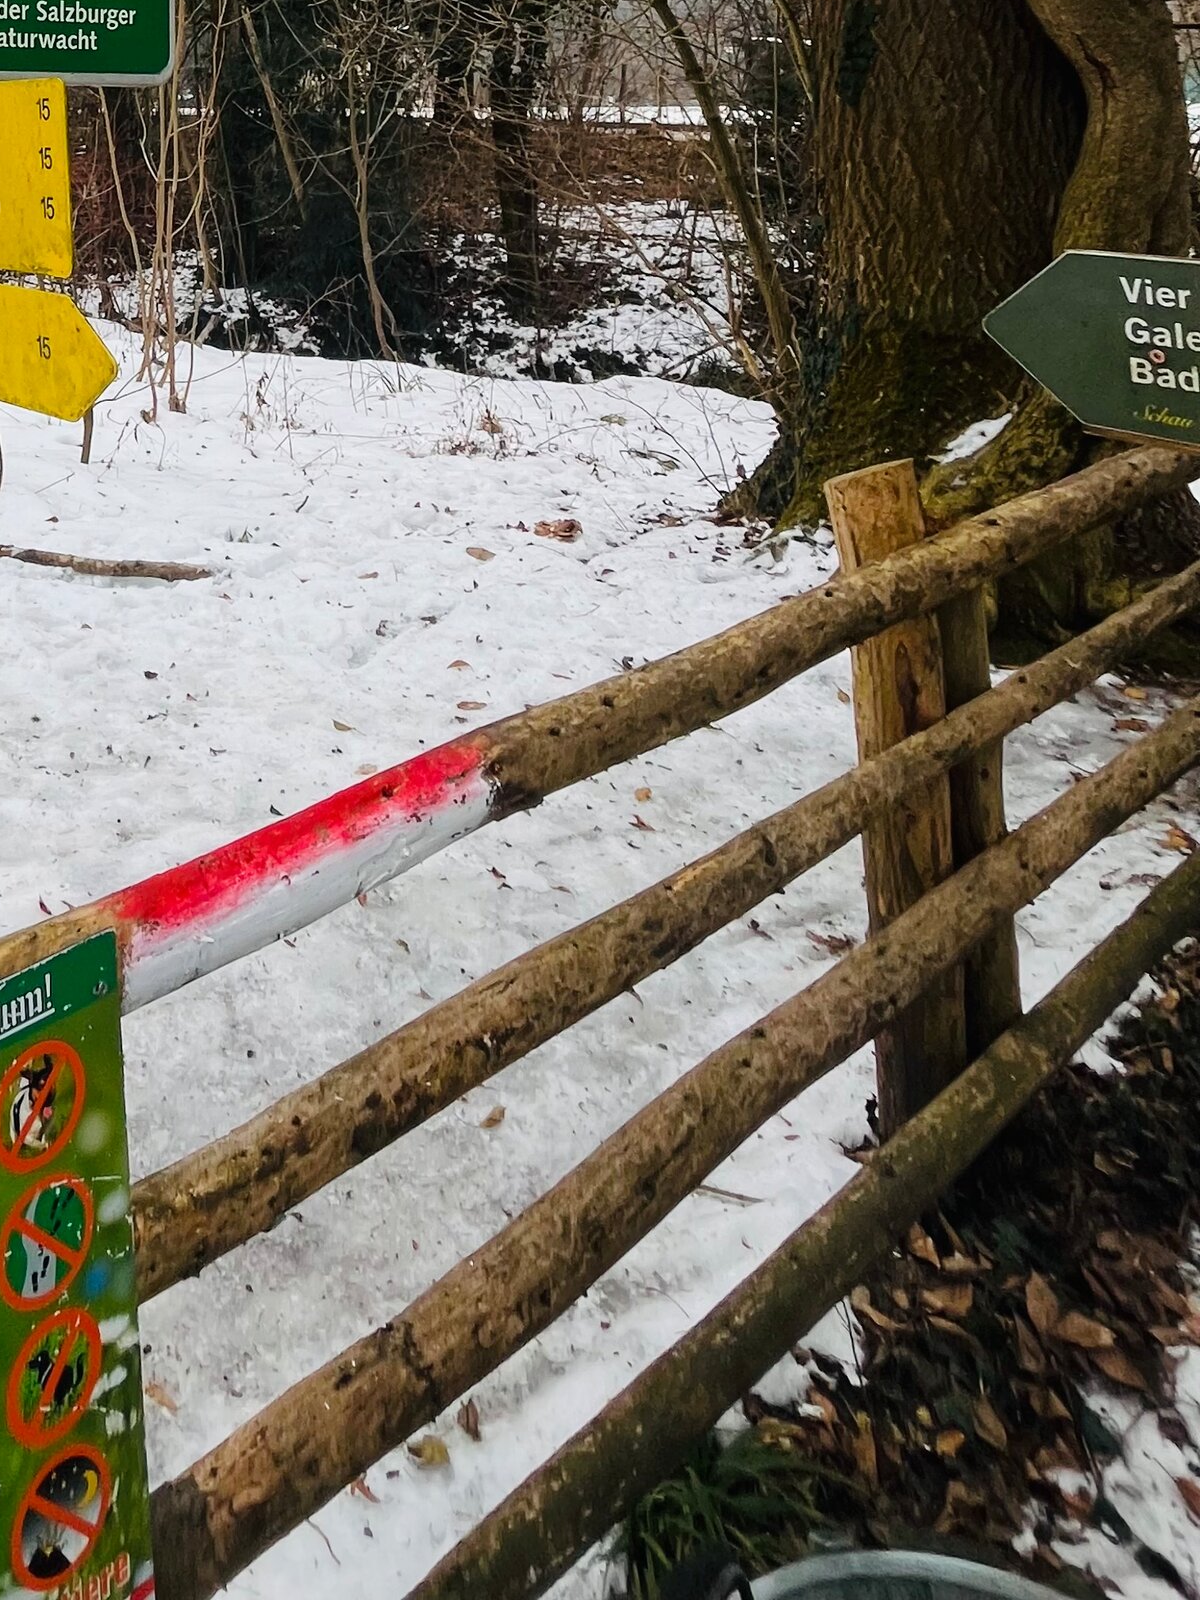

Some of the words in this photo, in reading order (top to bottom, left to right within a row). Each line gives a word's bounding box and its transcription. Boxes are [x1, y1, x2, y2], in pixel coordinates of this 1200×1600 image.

[36, 0, 136, 30] Salzburger
[36, 98, 50, 121] 15
[39, 147, 53, 169] 15
[41, 196, 55, 219] 15
[1119, 276, 1191, 310] Vier
[36, 335, 51, 360] 15
